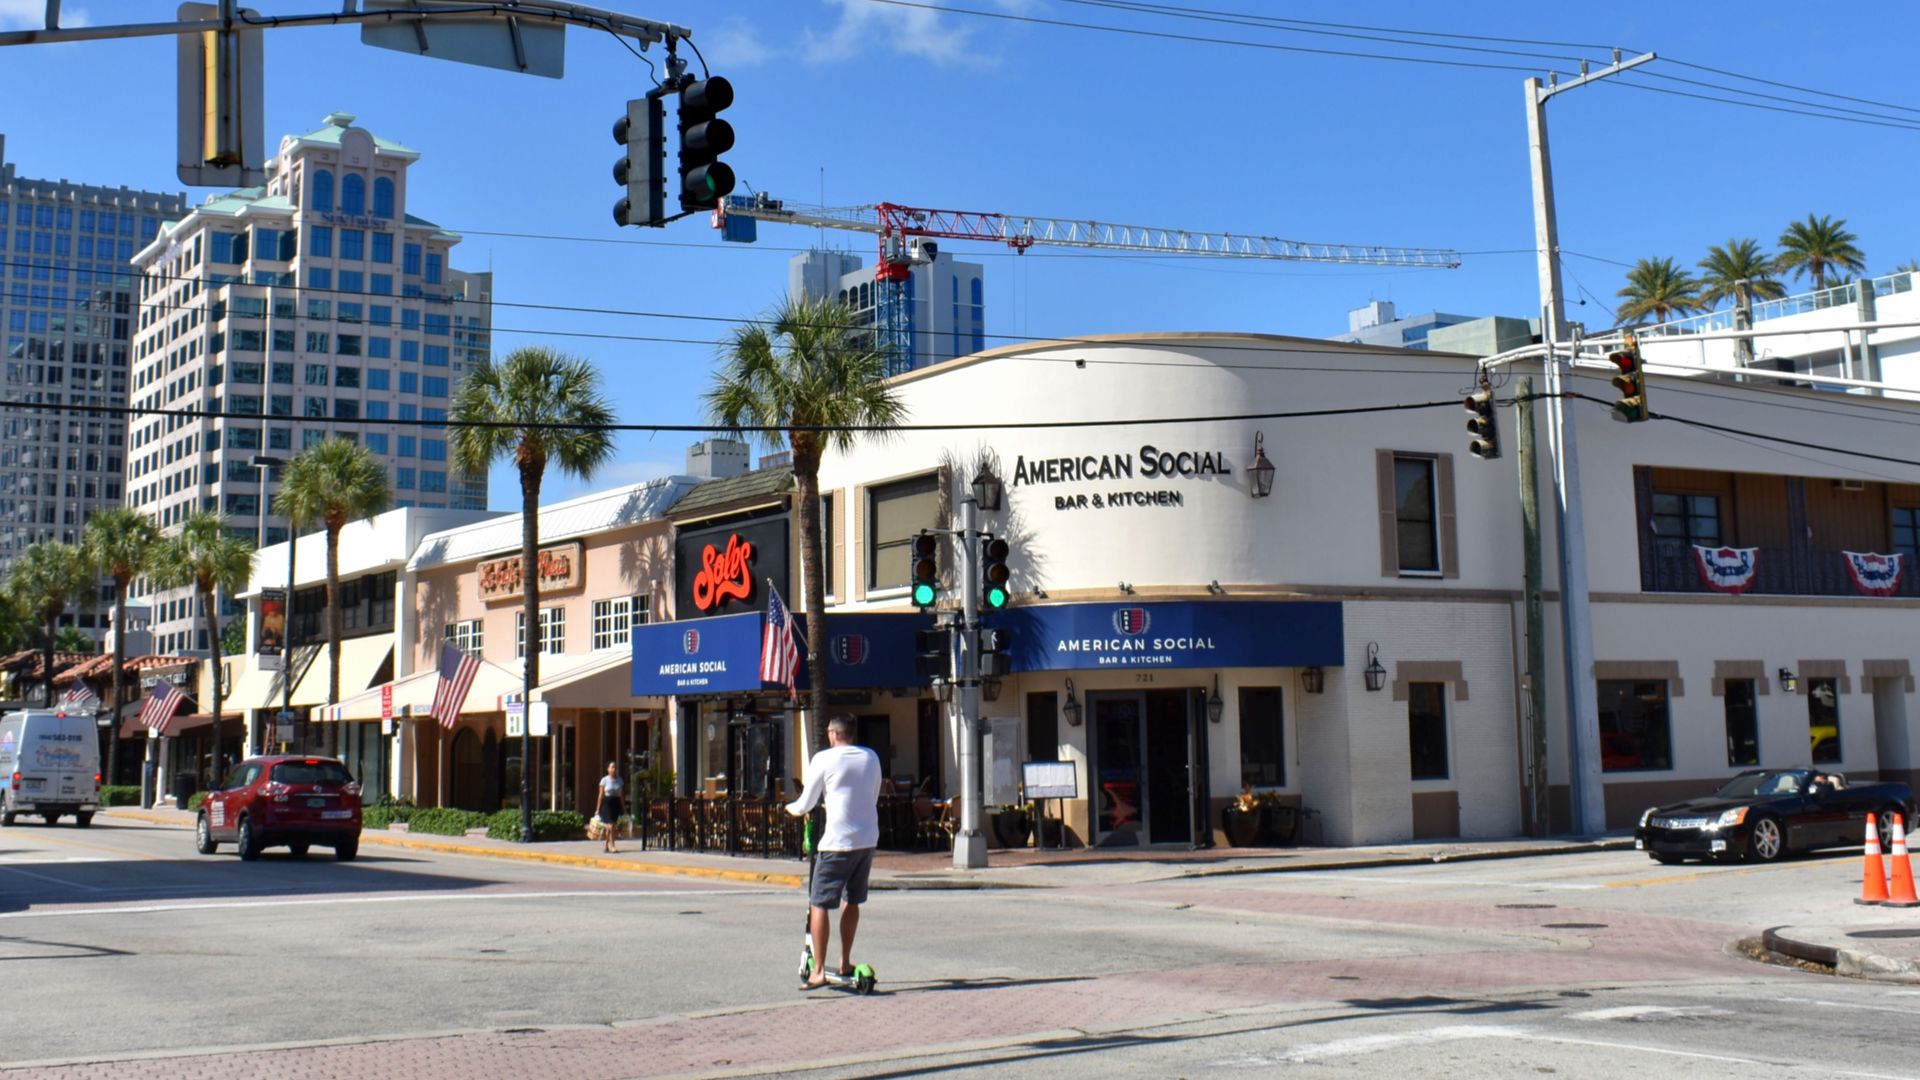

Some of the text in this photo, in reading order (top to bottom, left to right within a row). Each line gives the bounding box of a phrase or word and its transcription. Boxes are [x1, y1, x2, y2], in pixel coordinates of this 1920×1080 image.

[1055, 490, 1181, 510] BAR & KITCHEN
[1058, 637, 1215, 652] AMERICAN SOCIAL
[1099, 655, 1172, 664] BAR & KITCHEN
[659, 660, 726, 675] AMERICAN SOCIAL
[1136, 673, 1154, 683] 721
